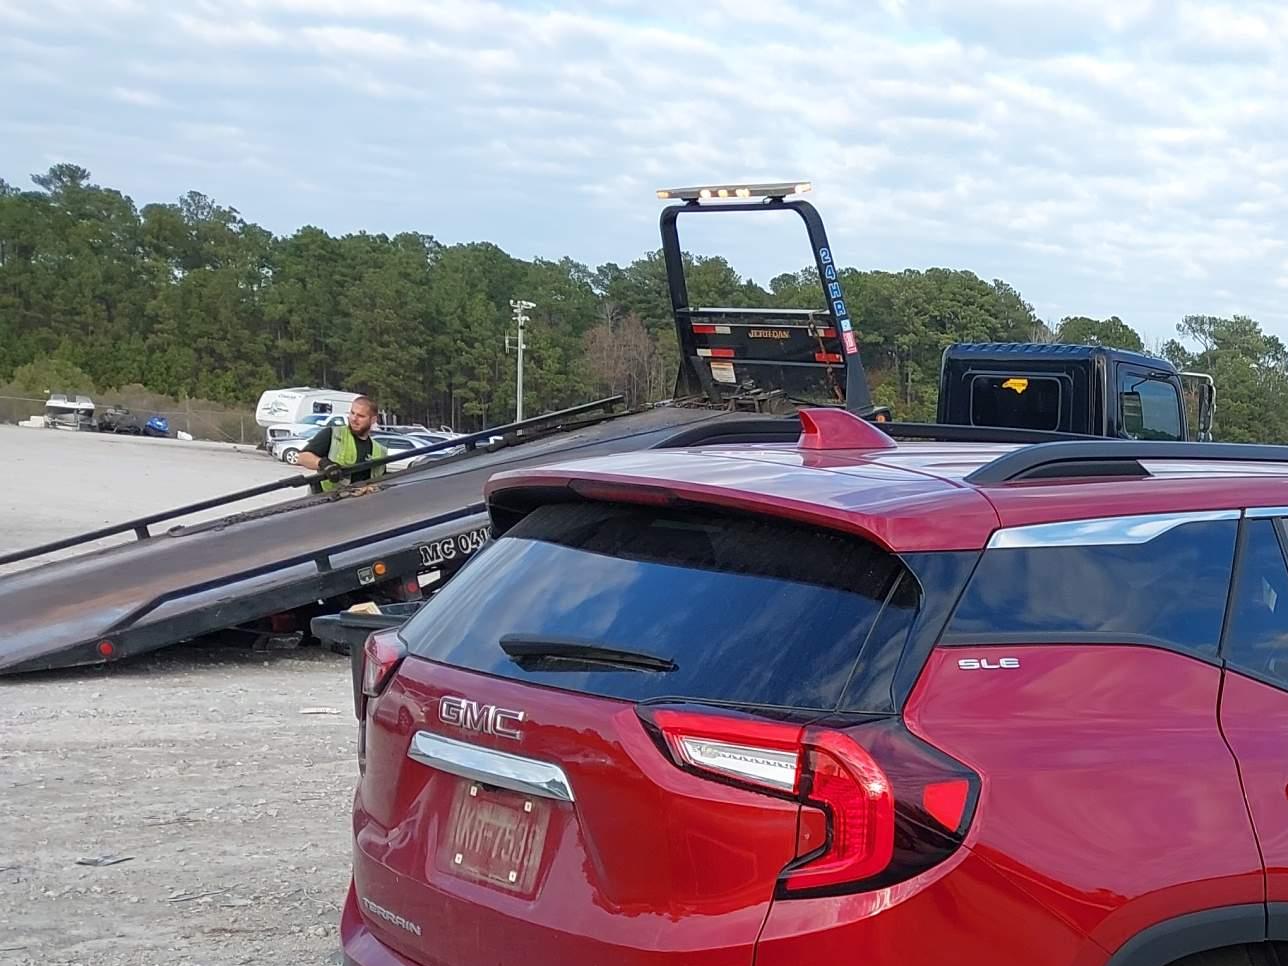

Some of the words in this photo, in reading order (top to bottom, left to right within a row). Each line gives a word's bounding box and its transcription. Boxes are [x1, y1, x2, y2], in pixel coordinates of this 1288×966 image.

[420, 537, 456, 565] MC
[958, 657, 1020, 669] SLE
[438, 695, 525, 740] GMC
[362, 897, 422, 936] TERRAIN
